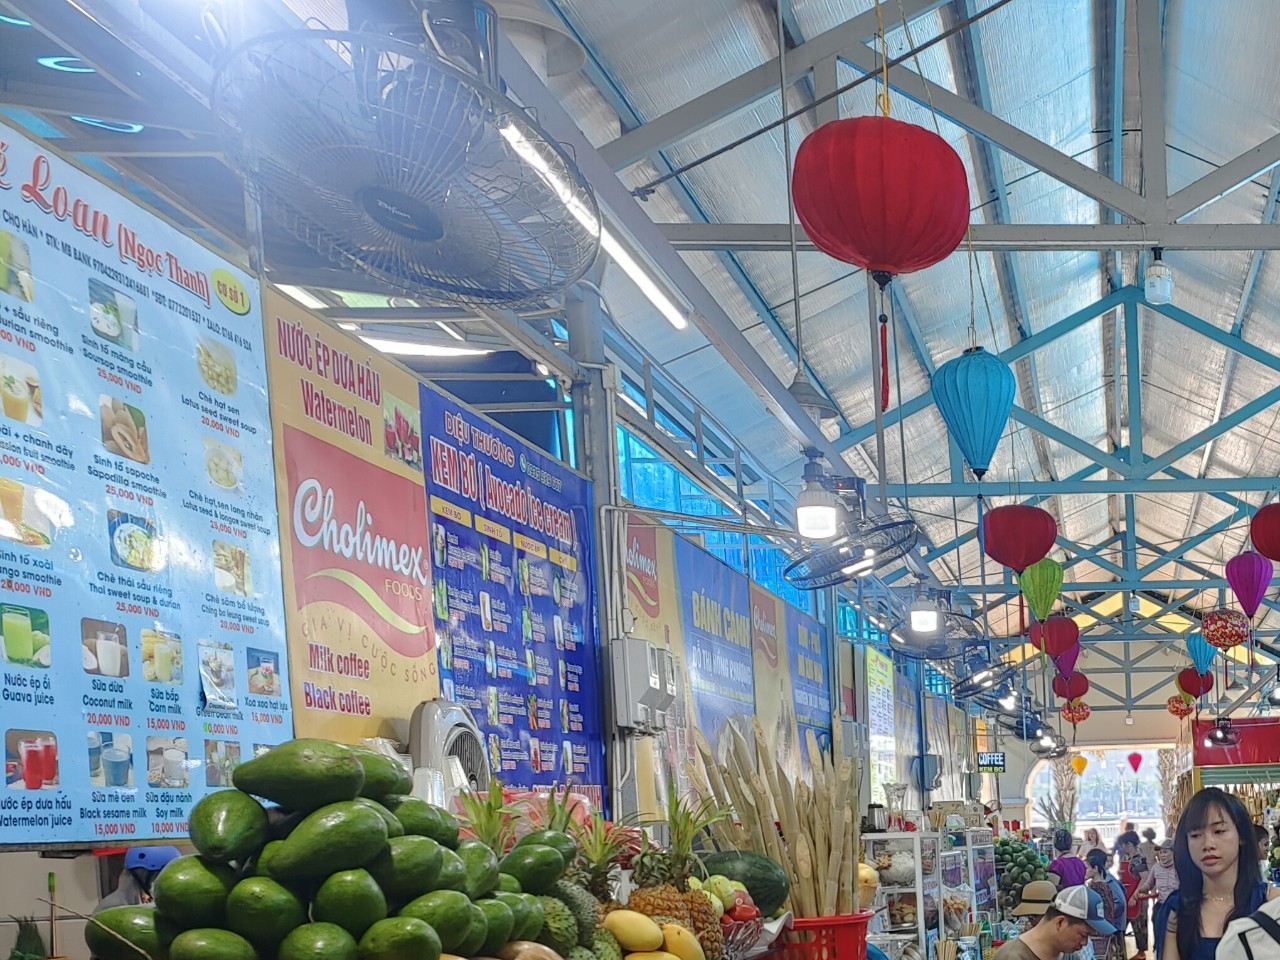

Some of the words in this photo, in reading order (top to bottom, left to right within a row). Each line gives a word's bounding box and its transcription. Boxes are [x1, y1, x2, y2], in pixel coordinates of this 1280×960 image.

[21, 155, 114, 248] Loan
[73, 248, 94, 269] BANK
[16, 335, 36, 353] VND
[29, 330, 74, 355] smoothie
[276, 318, 313, 371] NƯỚC
[315, 333, 330, 379] ÉP
[332, 349, 355, 396] DƯA
[357, 357, 381, 406] HẤU
[125, 380, 142, 394] VND
[300, 378, 373, 447] Watermelon
[225, 425, 240, 438] VND
[23, 434, 53, 451] chanh
[445, 411, 469, 447] DIỆU
[471, 427, 515, 468] THƯƠNG
[94, 454, 112, 469] Sinh
[430, 436, 460, 494] KEM
[460, 450, 478, 502] BƠ
[485, 464, 527, 526] Avocado
[545, 502, 572, 545] cream
[136, 493, 153, 506] VND
[293, 479, 427, 586] Cholimex
[22, 571, 62, 586] smoothie
[33, 586, 52, 598] VND
[108, 588, 131, 600] sweet
[132, 592, 150, 605] soup
[384, 578, 422, 601] FOODS
[144, 607, 159, 618] VND
[692, 587, 722, 638] BÁNH
[723, 606, 750, 649] CANH
[242, 623, 254, 634] VND
[308, 641, 334, 675] Milk
[336, 652, 370, 680] coffee
[4, 673, 27, 688] Nước
[30, 675, 41, 691] ép
[2, 688, 32, 703] Guava
[34, 691, 54, 707] juice
[83, 695, 116, 709] Coconut
[117, 699, 133, 710] milk
[304, 681, 337, 713] Black
[339, 691, 371, 717] coffee
[149, 701, 165, 713] Corn
[166, 703, 182, 715] milk
[87, 713, 113, 726] 20,000
[115, 715, 131, 727] VND
[147, 718, 170, 731] 15,000
[172, 719, 186, 731] VND
[270, 713, 283, 724] VND
[225, 723, 238, 735] VND
[979, 752, 1004, 765] COFFEE
[21, 798, 32, 812] ép
[80, 808, 101, 819] Black
[103, 809, 131, 819] sesame
[133, 808, 147, 818] milk
[156, 808, 168, 821] Soy
[170, 808, 184, 818] milk
[52, 814, 72, 829] juice
[95, 823, 118, 835] 15,000
[121, 823, 136, 834] VND
[152, 822, 175, 834] 10,000
